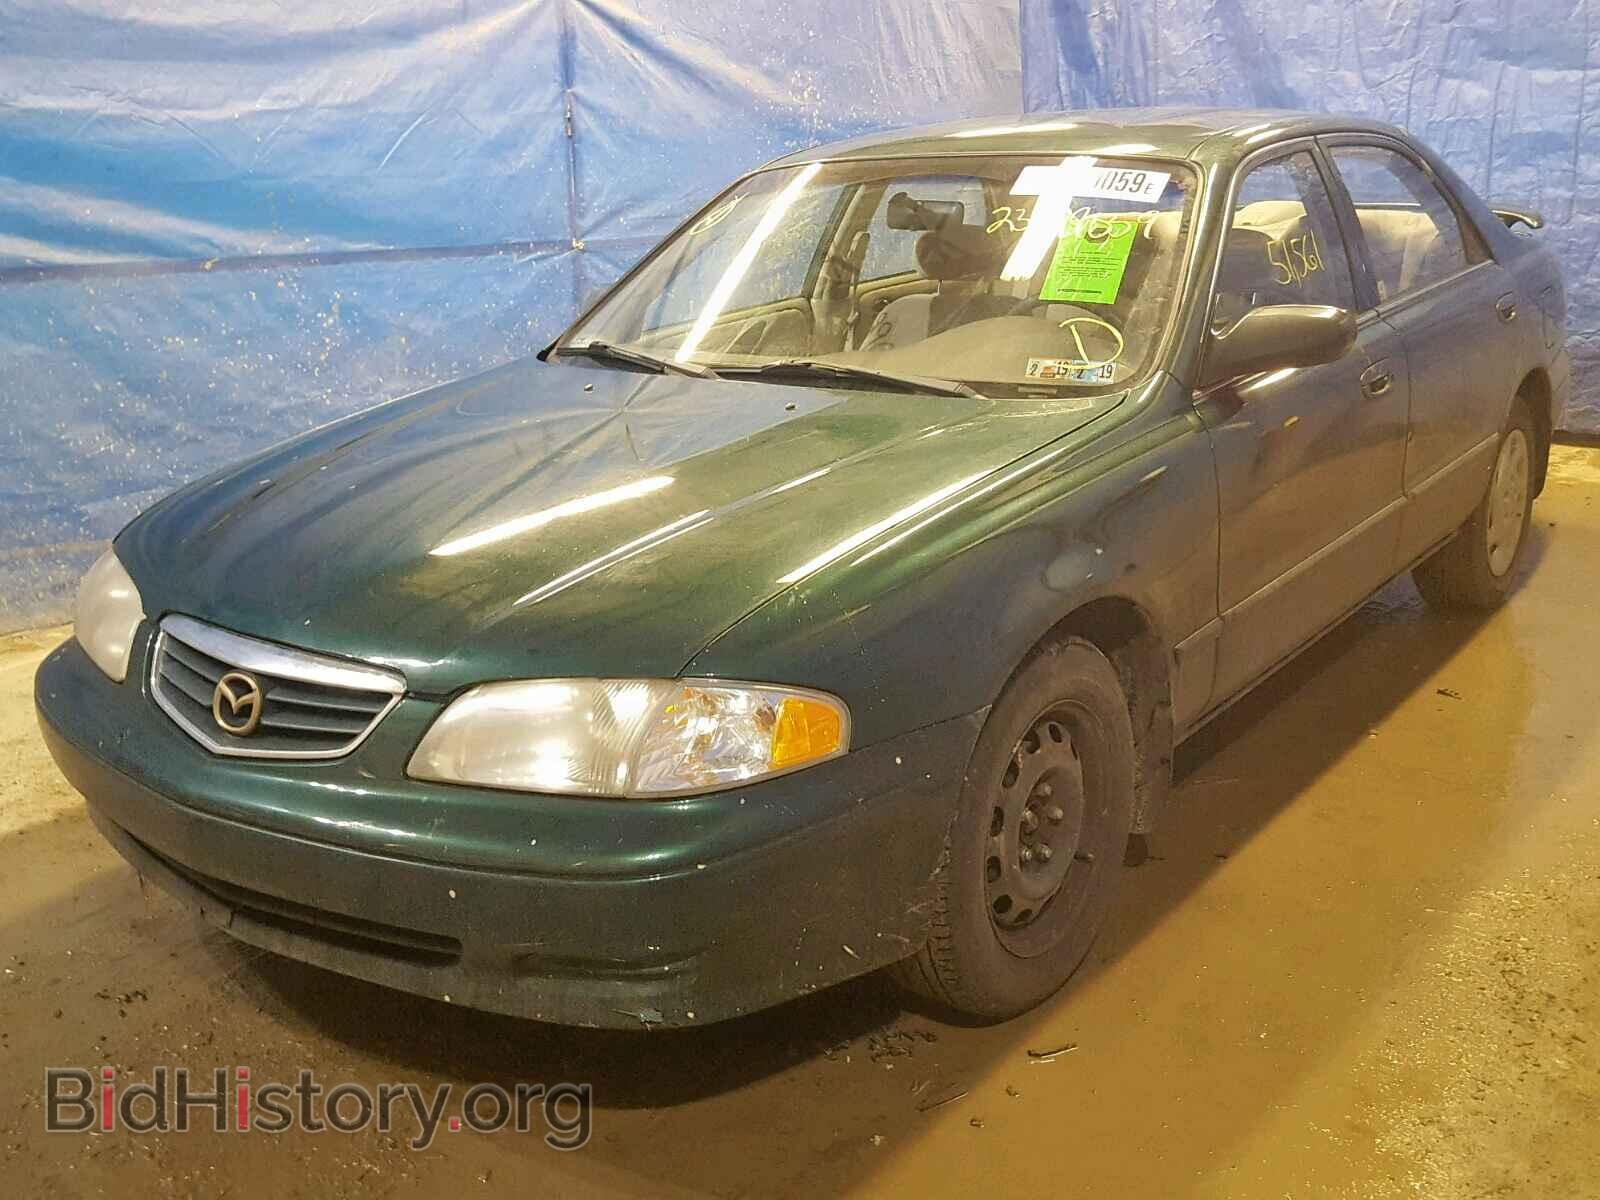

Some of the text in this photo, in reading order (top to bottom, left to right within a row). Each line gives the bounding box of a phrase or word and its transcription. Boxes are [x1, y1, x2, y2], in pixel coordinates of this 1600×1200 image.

[1058, 317, 1124, 369] D
[1030, 361, 1038, 376] 2
[1100, 364, 1113, 379] 19
